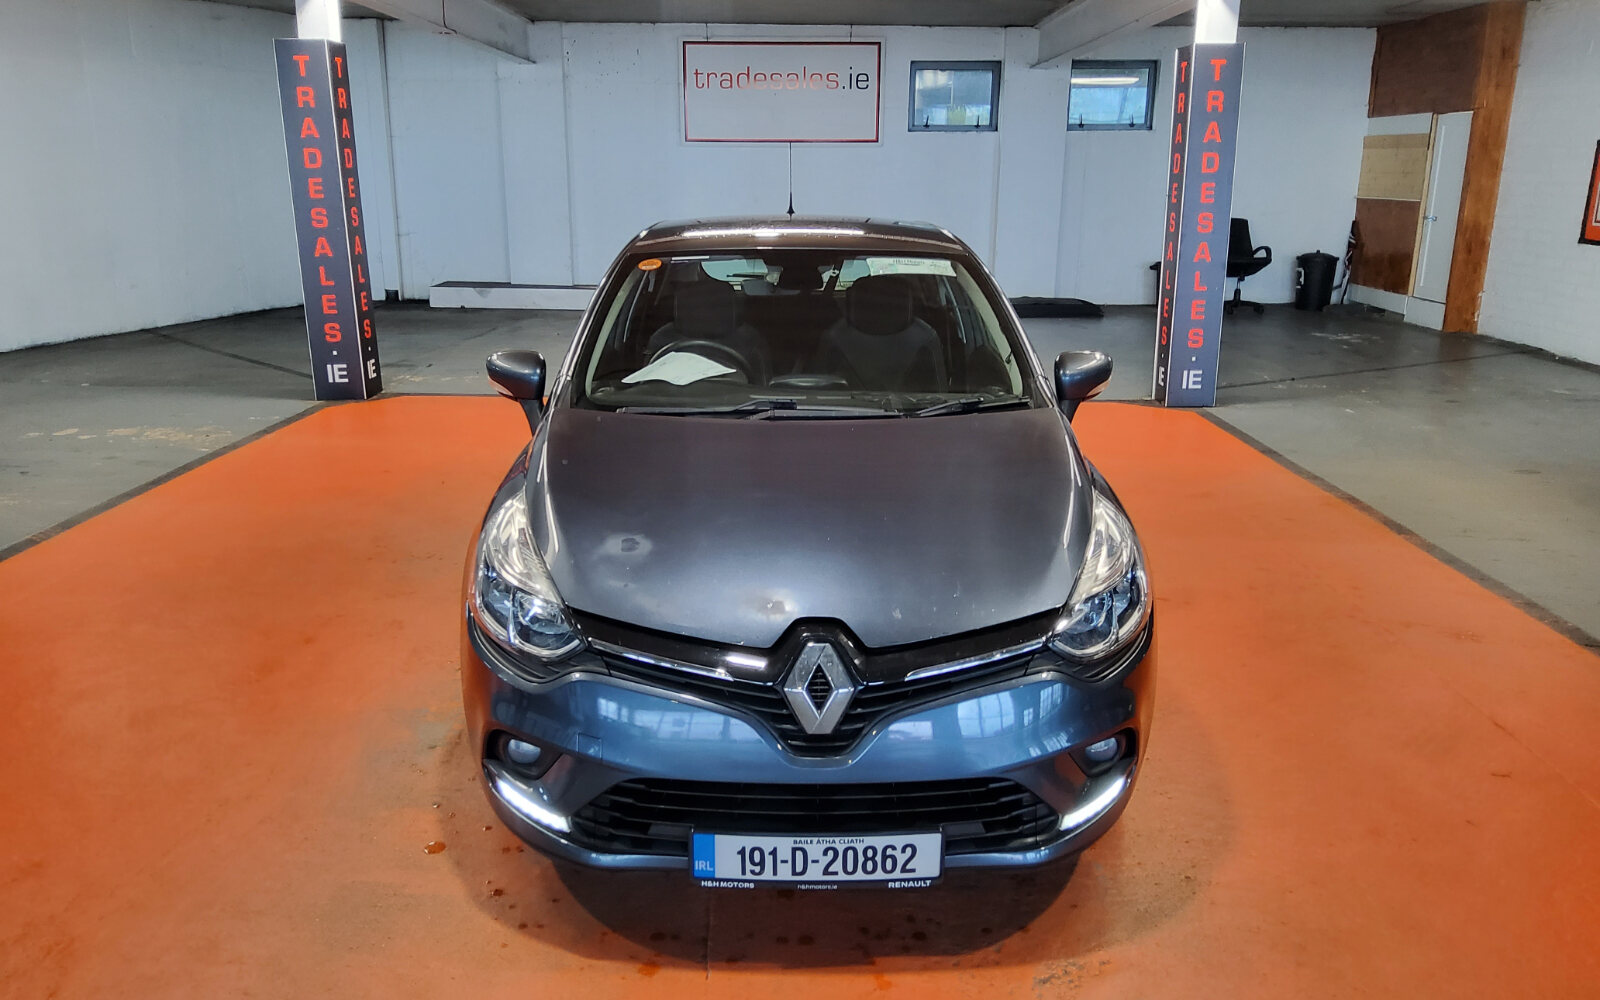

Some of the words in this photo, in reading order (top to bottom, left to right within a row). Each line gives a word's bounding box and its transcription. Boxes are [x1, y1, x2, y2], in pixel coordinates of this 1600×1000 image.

[693, 66, 870, 90] tradesales.ie
[694, 859, 714, 871] IRL
[736, 843, 918, 877] 191-D-20862
[701, 880, 719, 888] H&H
[720, 881, 755, 889] MOTORS
[888, 880, 932, 888] RENAULT
